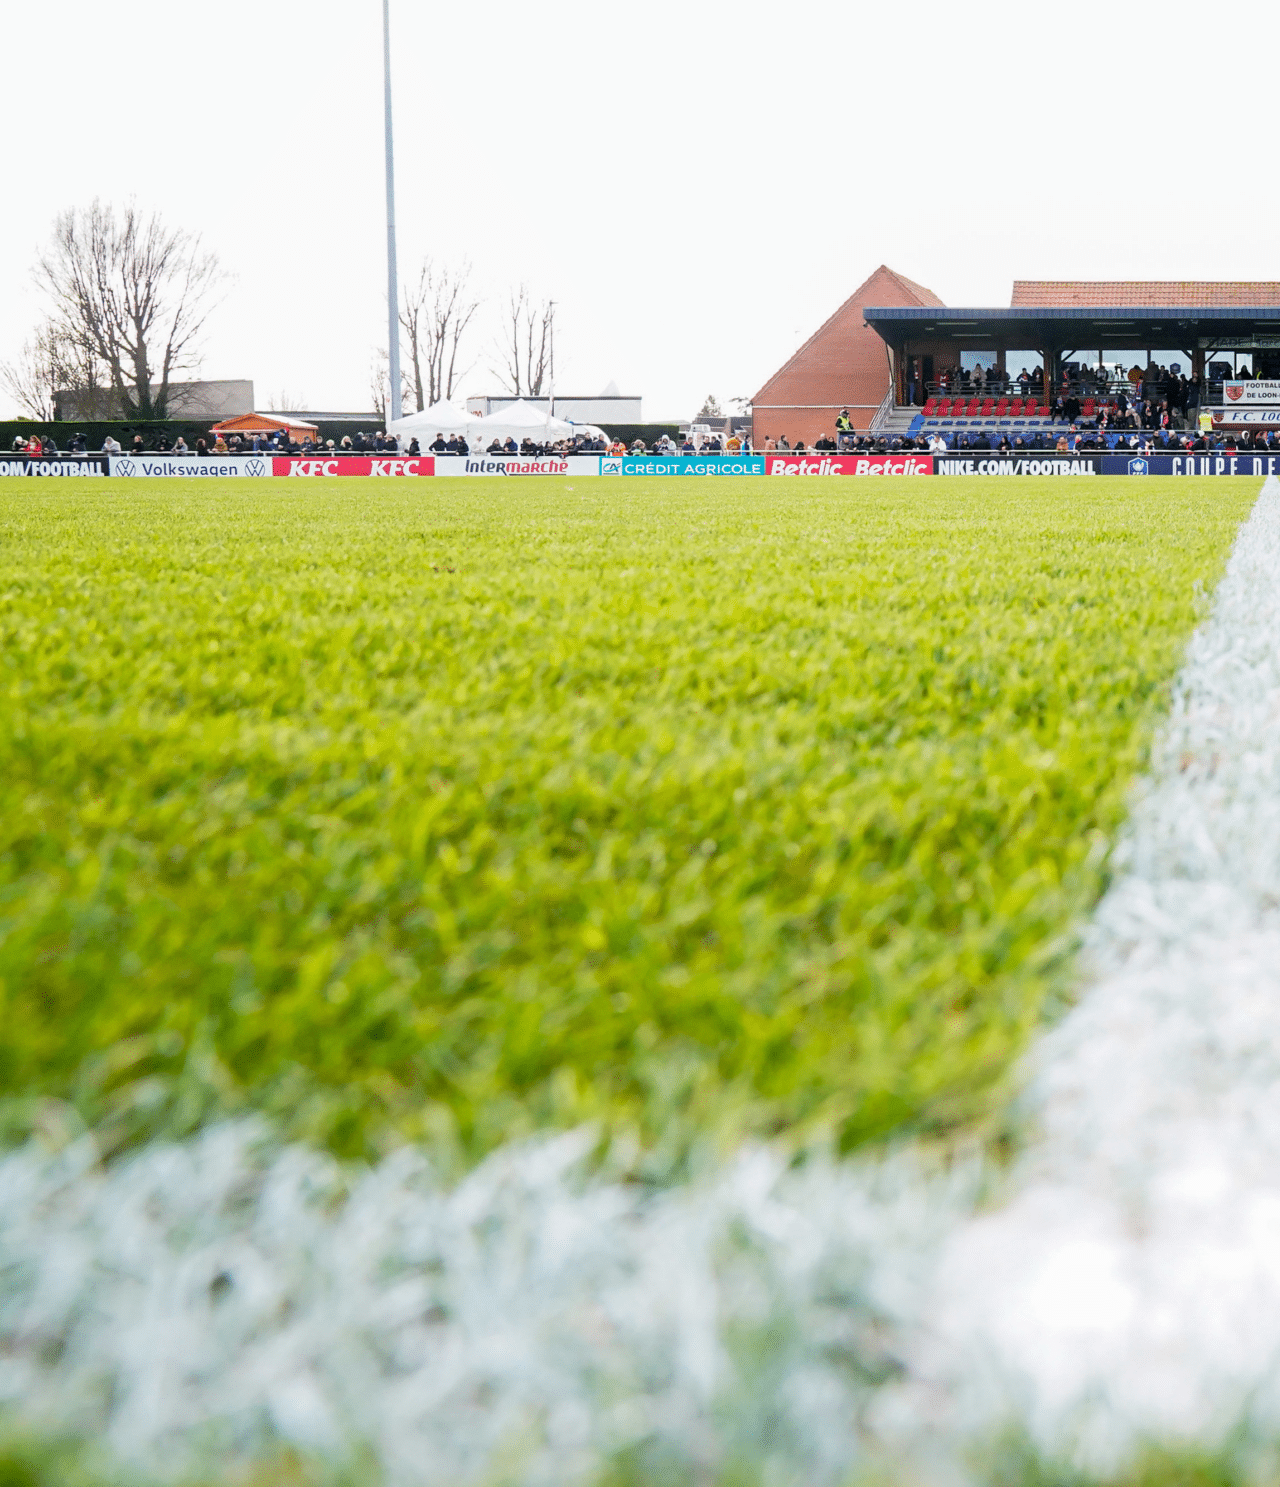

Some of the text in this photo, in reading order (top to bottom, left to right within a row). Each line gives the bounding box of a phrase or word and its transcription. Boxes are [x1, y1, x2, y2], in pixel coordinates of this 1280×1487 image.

[1232, 412, 1256, 422] F.C.
[0, 461, 105, 476] OM/FOOTBALL
[142, 462, 237, 476] Volkswagen
[289, 460, 339, 476] KFC
[370, 460, 420, 476] KFC
[465, 459, 569, 475] Intermarché
[624, 460, 761, 474] CRÉDIT AGRICOLE
[771, 459, 844, 475] Betclic
[855, 459, 928, 475] Betclic
[938, 460, 1096, 476] NIKE.COM/FOOTBALL
[1172, 458, 1239, 476] COUPE
[1253, 458, 1276, 476] DE
